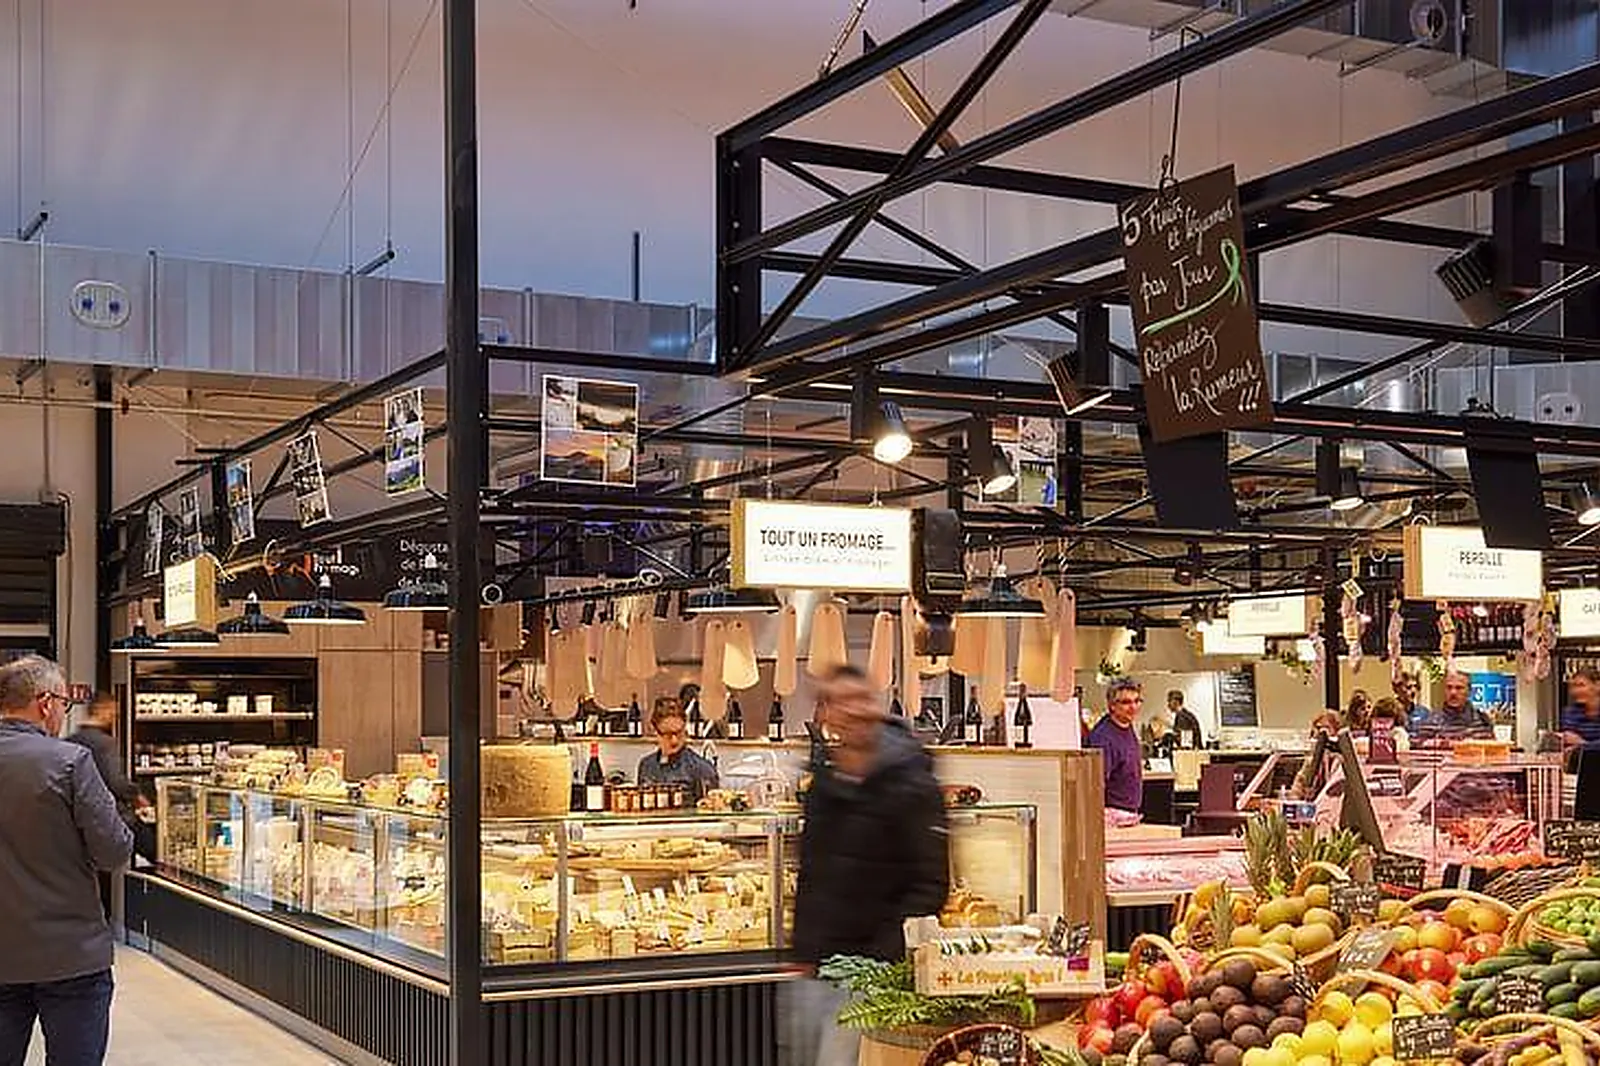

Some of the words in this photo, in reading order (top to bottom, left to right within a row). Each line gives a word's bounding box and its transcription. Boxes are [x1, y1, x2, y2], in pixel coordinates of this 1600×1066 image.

[1121, 202, 1140, 246] 5
[400, 539, 449, 556] Dégusta
[760, 529, 796, 547] TOUT
[798, 531, 818, 548] UN
